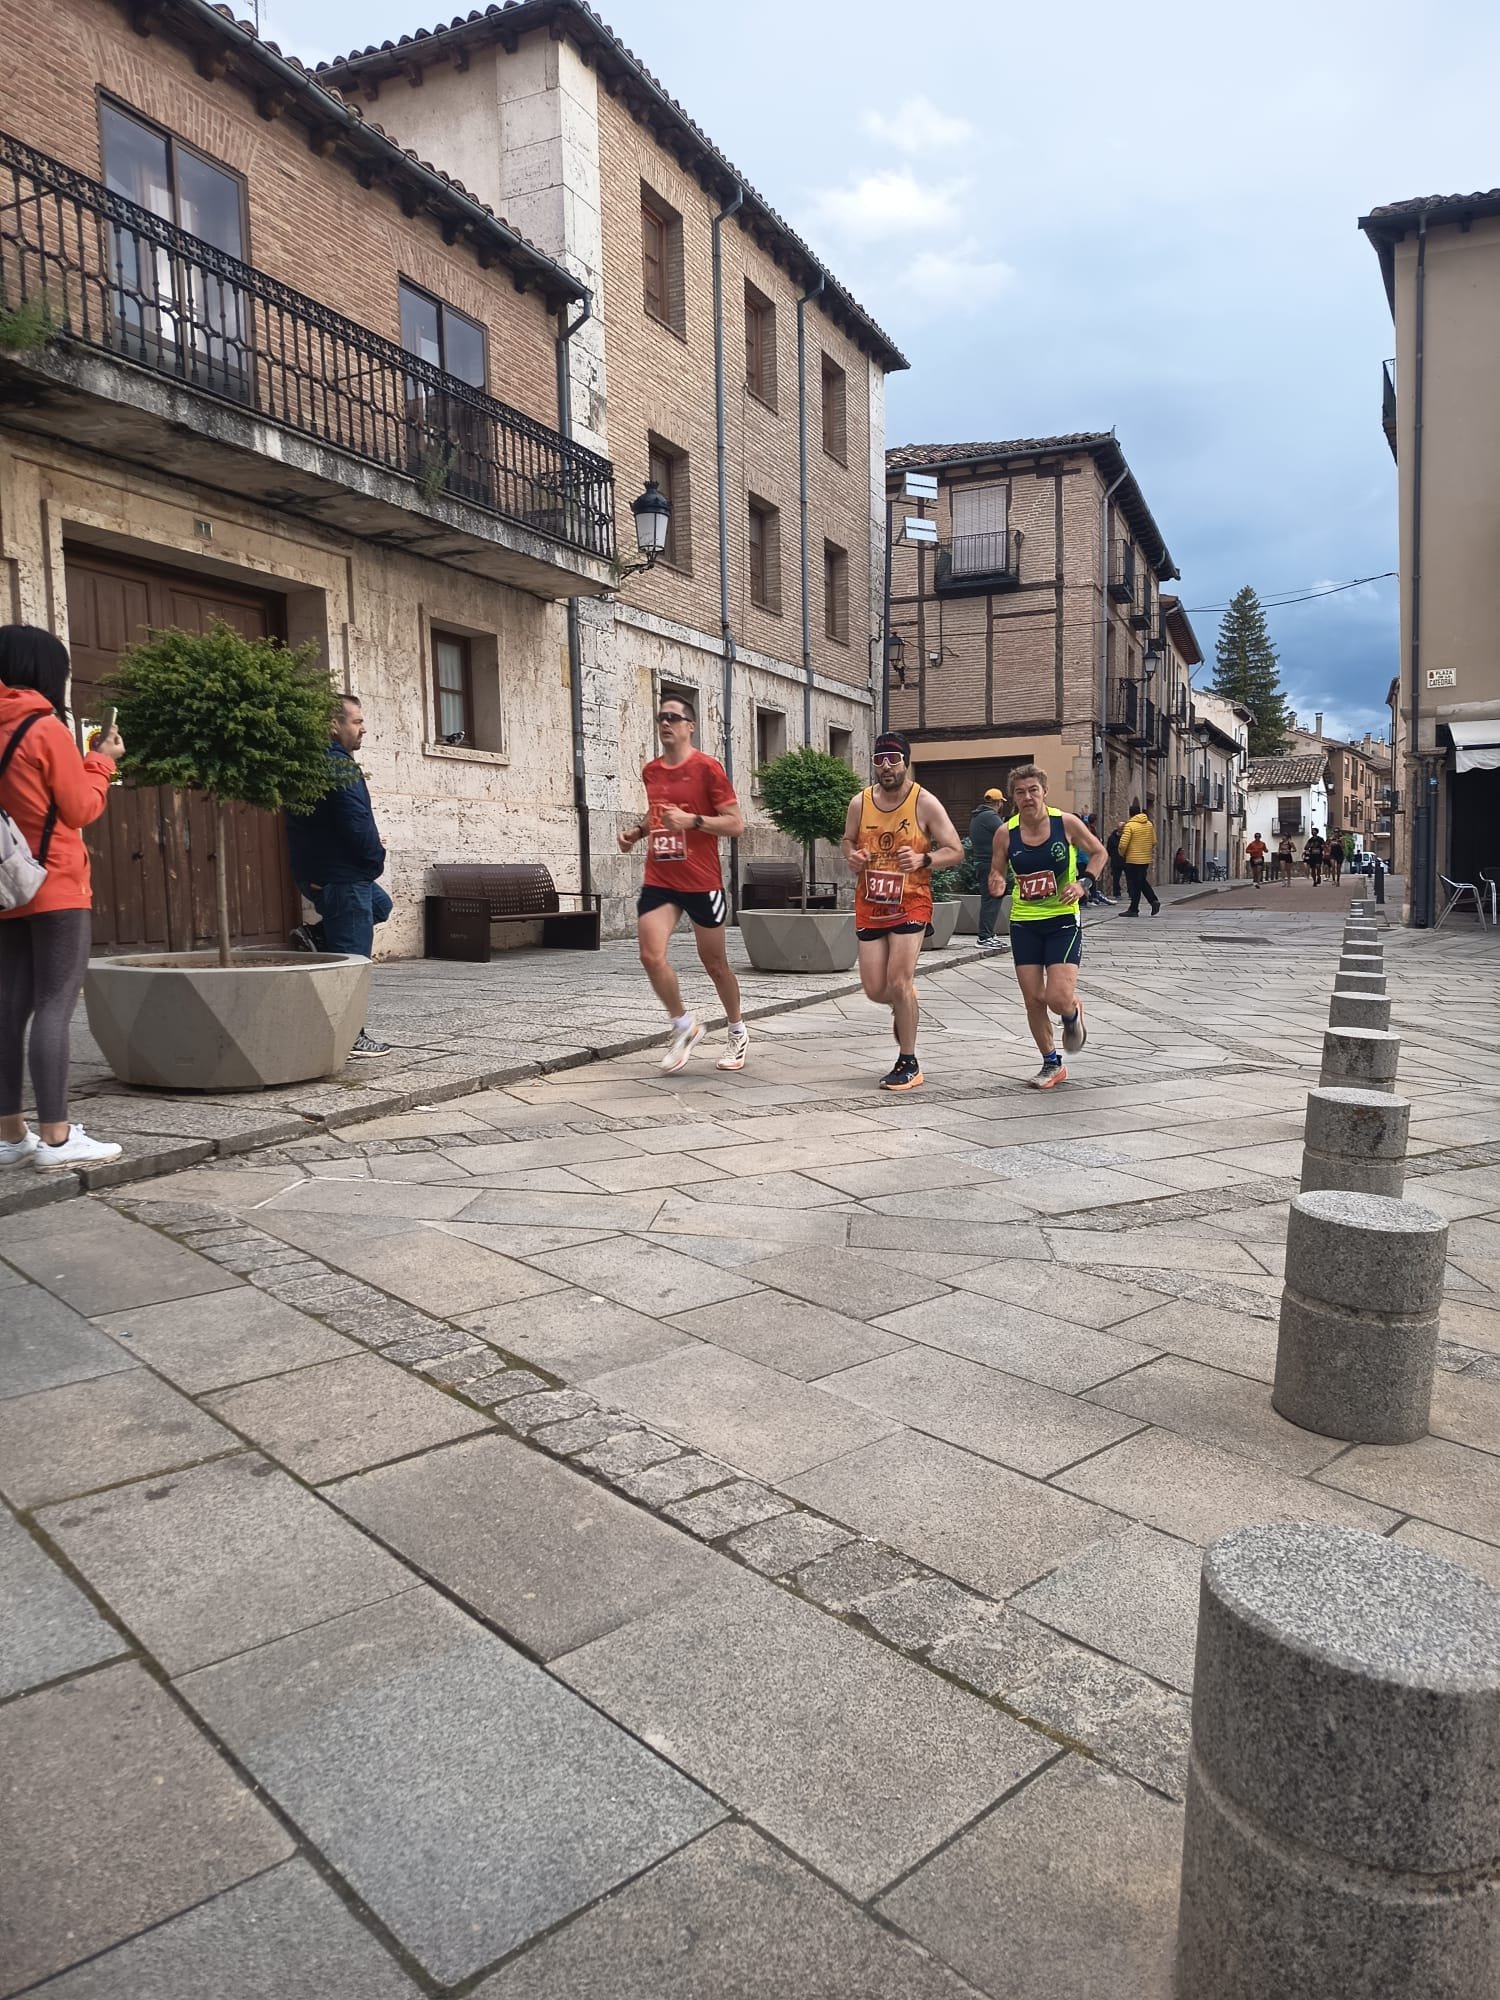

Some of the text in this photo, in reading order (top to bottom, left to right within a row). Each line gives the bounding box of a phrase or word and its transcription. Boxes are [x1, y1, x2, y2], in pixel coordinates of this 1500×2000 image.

[1429, 678, 1453, 686] CATEDRAL
[653, 836, 677, 850] 421
[869, 878, 895, 894] 311
[1022, 877, 1047, 893] 477
